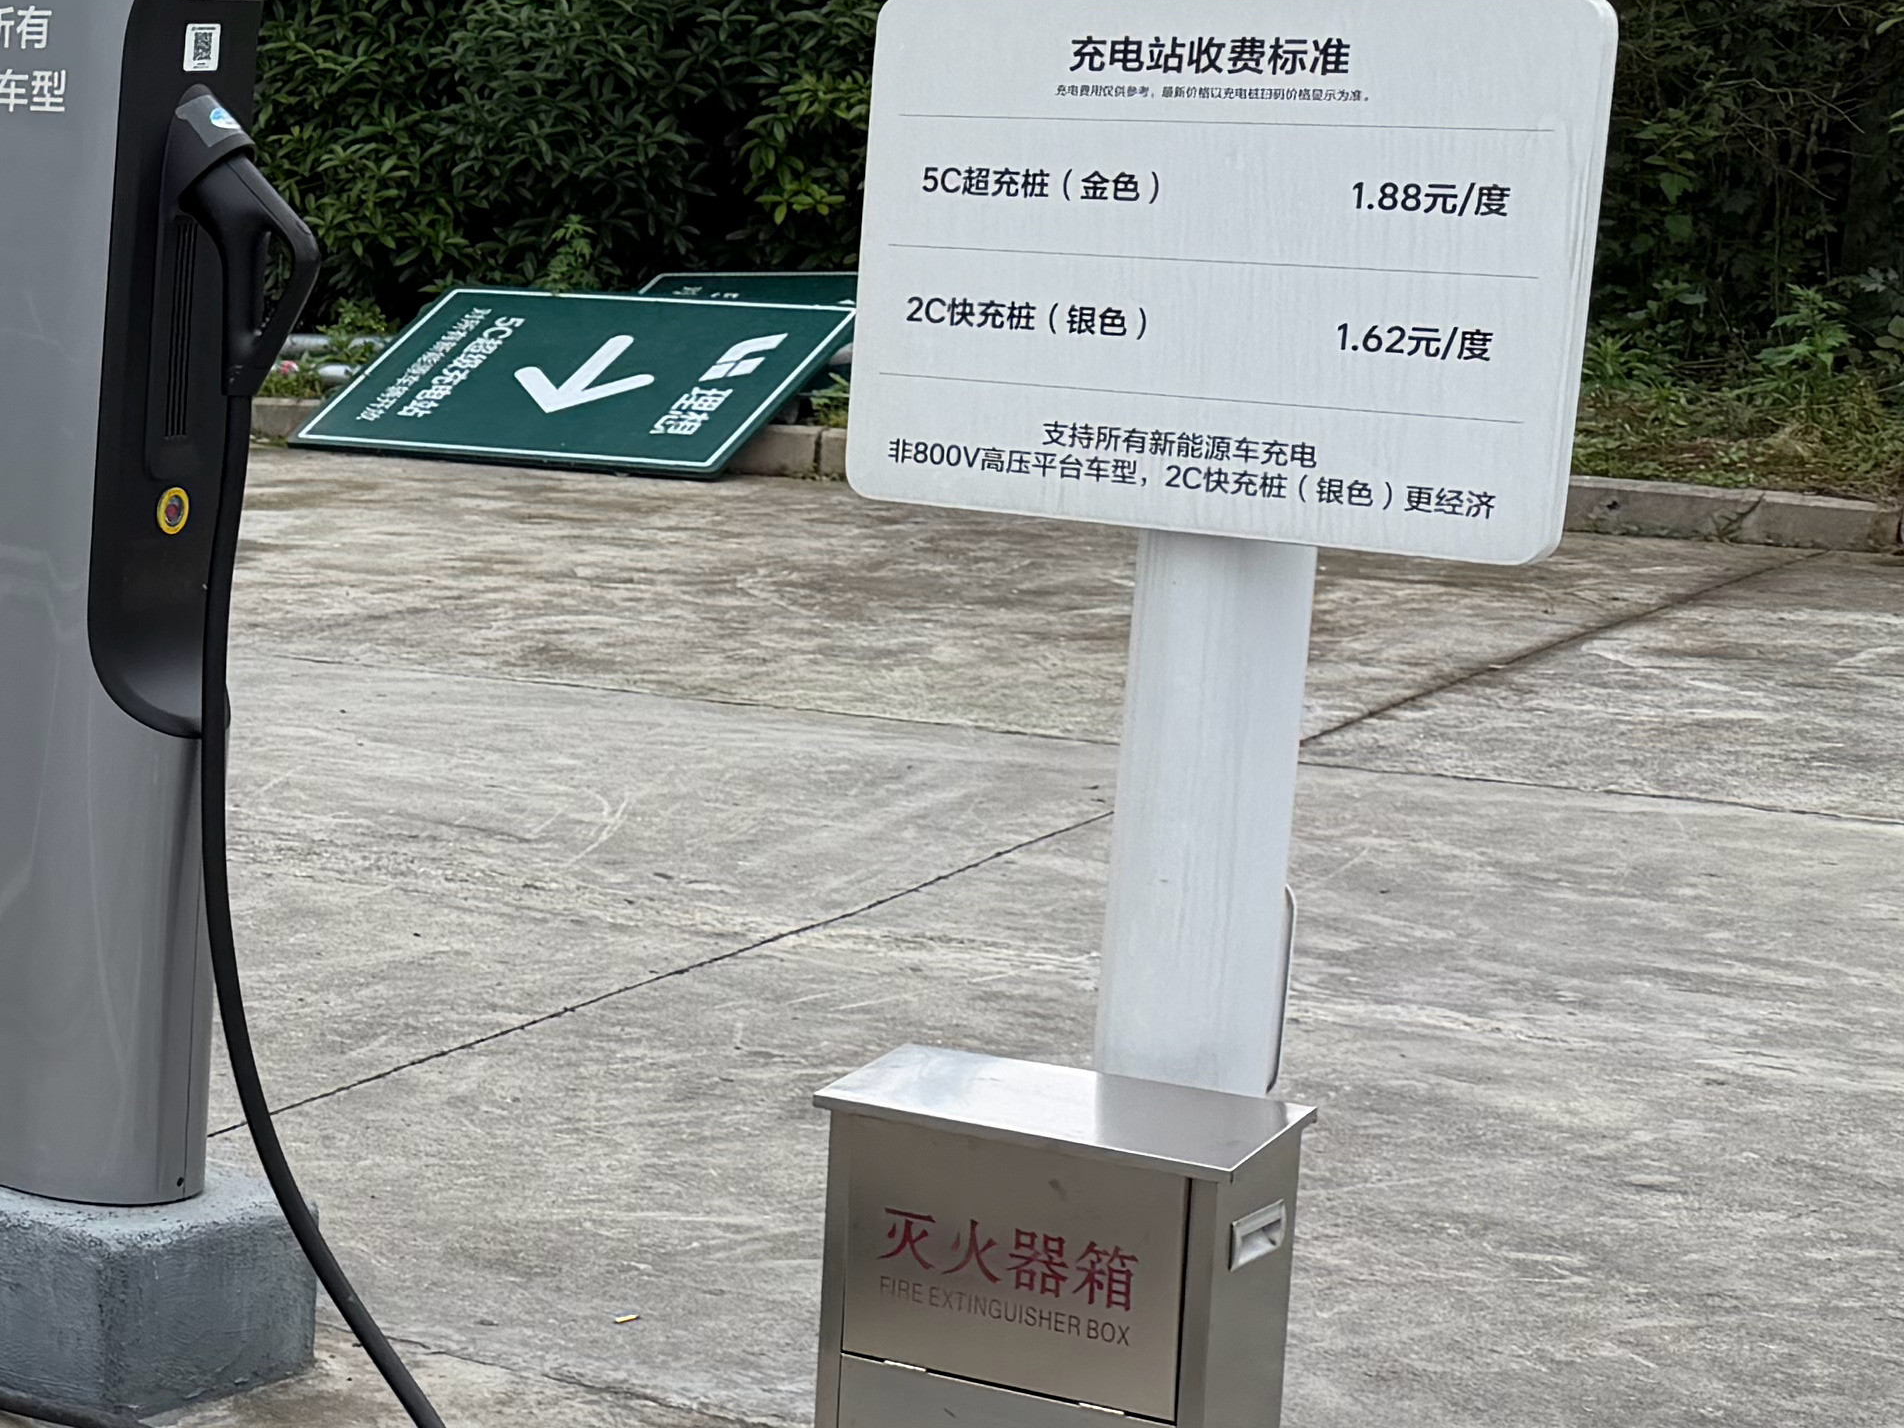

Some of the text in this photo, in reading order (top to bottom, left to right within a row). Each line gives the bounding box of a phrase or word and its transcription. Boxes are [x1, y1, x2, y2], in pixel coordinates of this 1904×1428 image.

[1069, 36, 1350, 75] 充电站收费标准
[1351, 181, 1510, 219] 1.88元/度
[1336, 322, 1493, 363] 1.62元/度
[1042, 423, 1317, 470] 支持所有新能源车充电
[876, 1207, 1139, 1313] 灭火器箱
[879, 1276, 1131, 1347] FIRE EXTINGUISHER BOX
